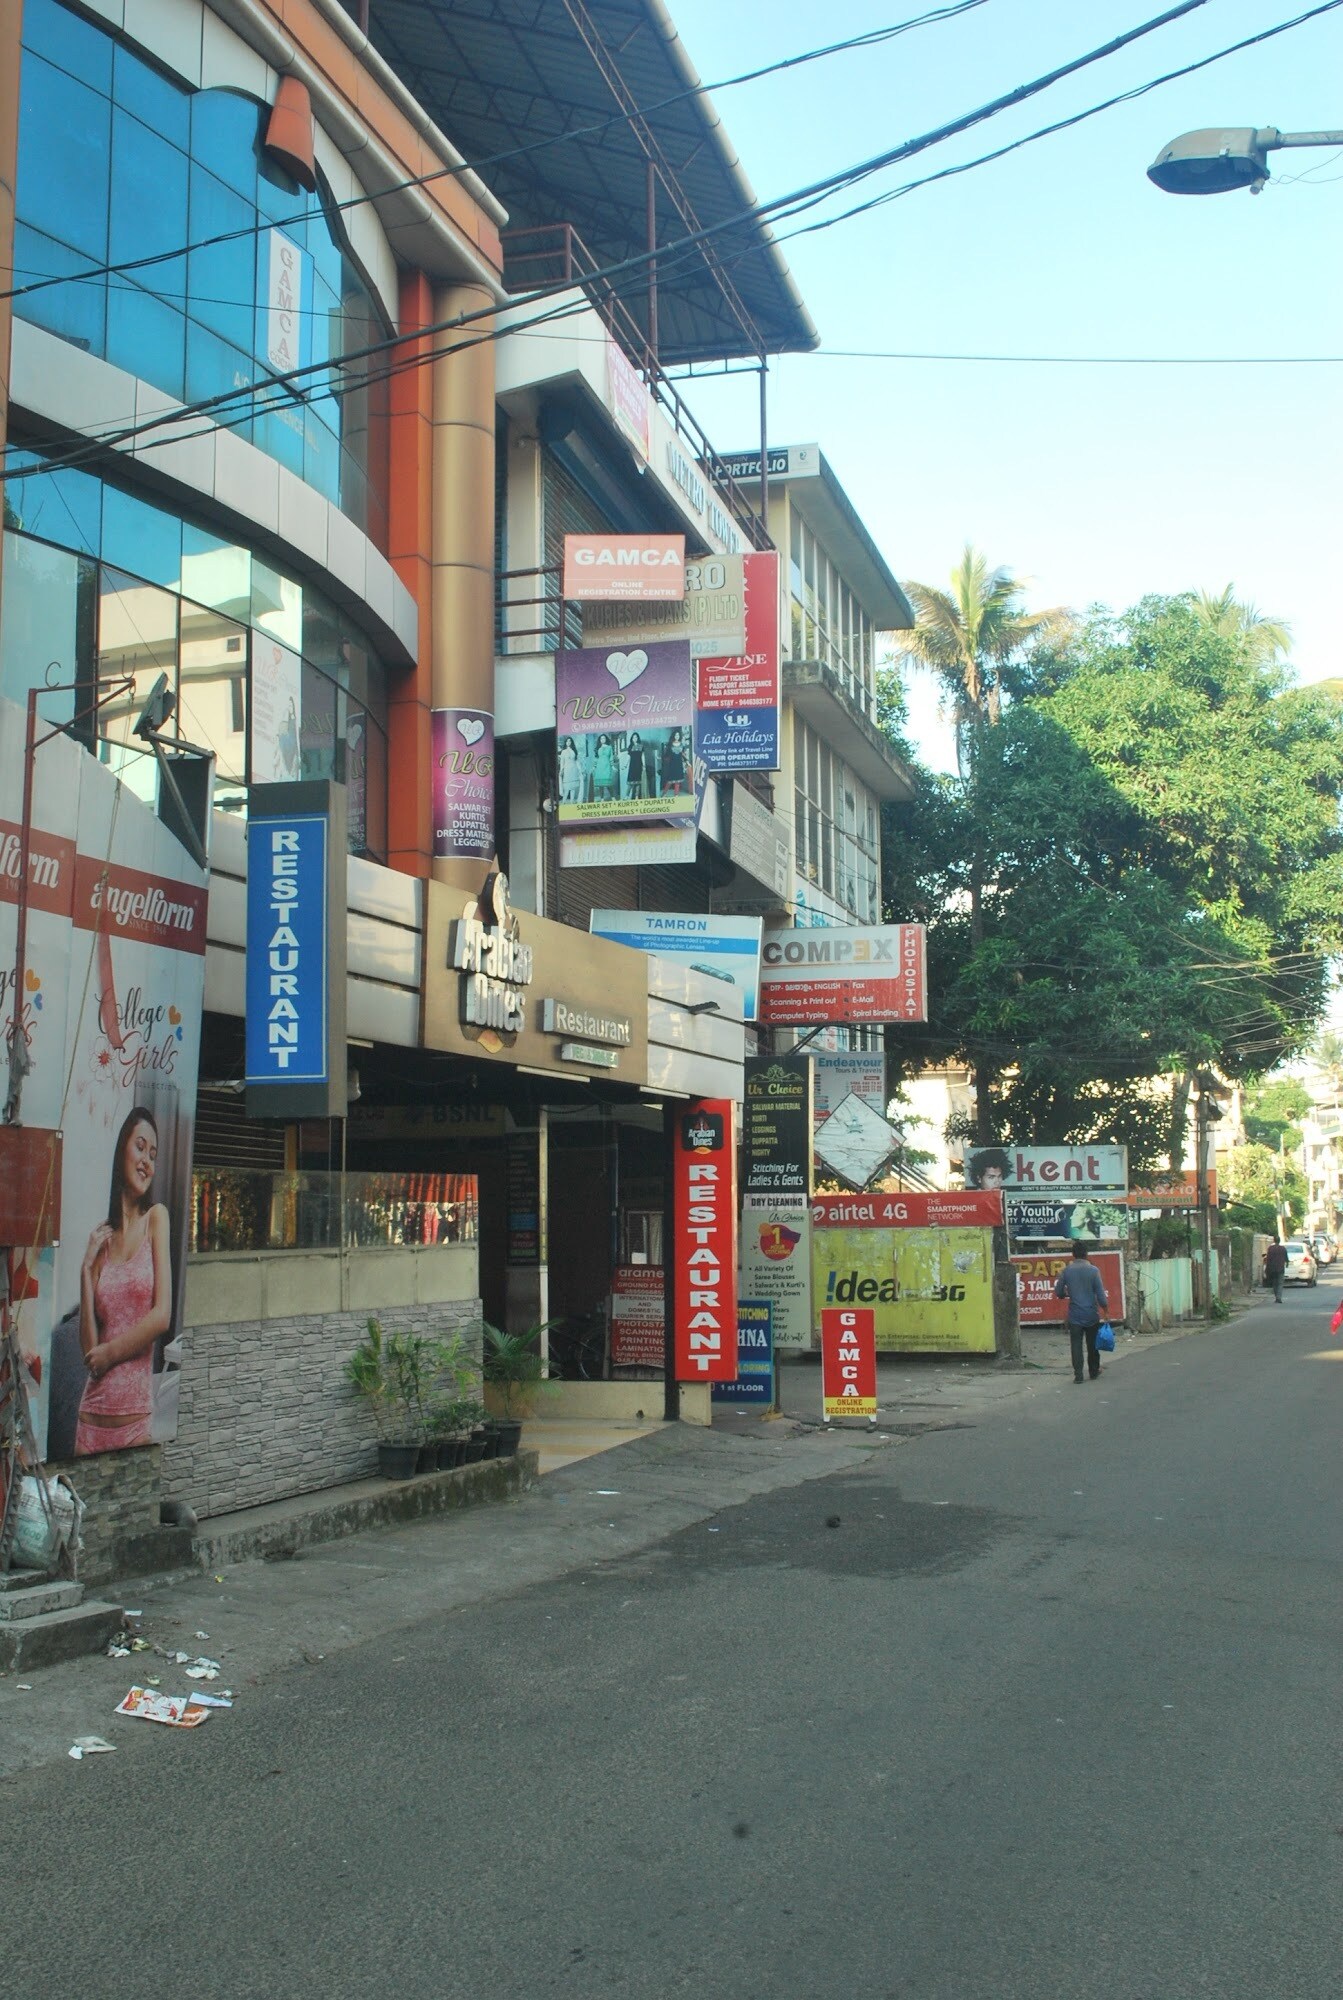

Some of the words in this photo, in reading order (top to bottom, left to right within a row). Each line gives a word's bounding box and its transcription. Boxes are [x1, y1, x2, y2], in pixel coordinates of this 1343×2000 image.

[278, 247, 294, 360] GAMCA
[574, 549, 681, 566] GAMCA
[586, 605, 632, 629] KURIES
[650, 600, 692, 625] LOANS
[695, 595, 711, 627] (P)
[715, 594, 739, 620] LTD
[709, 682, 737, 690] PASSPORT
[739, 680, 772, 688] ASSISTANCE
[723, 688, 756, 696] ASSISTANCE
[562, 694, 626, 720] UR
[630, 694, 686, 715] Choice
[720, 699, 734, 707] STAY
[702, 733, 721, 745] Lia
[724, 730, 775, 746] Holidays
[728, 753, 769, 761] OPERATORS
[448, 803, 480, 812] SALWAR
[482, 805, 491, 815] SET
[577, 802, 600, 811] SALWAR
[618, 800, 639, 808] KURTIS
[644, 798, 675, 806] DUPATTAS
[460, 811, 486, 822] KURTIS
[581, 810, 601, 818] DRESS
[602, 808, 635, 817] MATERIALS
[640, 806, 670, 814] LEGGINGS
[453, 820, 489, 832] DUPATTAS
[437, 829, 464, 838] DRESS
[454, 838, 489, 849] LEGGINGS
[90, 881, 195, 932] angelform
[646, 918, 707, 931] TAMRON
[268, 830, 301, 1068] RESTAURANT
[458, 901, 533, 986] Arabian
[648, 942, 684, 950] Photographic
[904, 929, 917, 1016] PHOTOSTAT
[770, 999, 802, 1007] Scanning
[95, 987, 165, 1043] College
[770, 1012, 805, 1020] Computer
[806, 1011, 829, 1020] Typing
[873, 1009, 899, 1017] Binding
[556, 1003, 631, 1043] Restaurant
[119, 1030, 179, 1088] Girls
[818, 1057, 882, 1067] Endeavour
[747, 1084, 762, 1095] Ur
[768, 1083, 804, 1095] Choice
[752, 1103, 774, 1111] SALWAR
[775, 1102, 801, 1110] MATERIAL
[432, 1104, 497, 1123] BSNL
[688, 1128, 716, 1138] Arabian
[693, 1136, 713, 1146] Dines
[752, 1163, 784, 1174] Stitching
[786, 1163, 799, 1172] For
[1016, 1153, 1100, 1182] kent
[748, 1175, 771, 1186] Ladies
[773, 1175, 779, 1185] &
[782, 1175, 804, 1186] Gents
[751, 1197, 765, 1207] DRY
[767, 1197, 803, 1207] CLEANING
[1136, 1196, 1194, 1204] Restaurant
[829, 1203, 875, 1221] airtel
[883, 1203, 907, 1220] 4G
[927, 1205, 977, 1213] SMARTPHONE
[1020, 1206, 1054, 1217] Youth
[781, 1212, 804, 1223] Choice
[772, 1227, 780, 1245] 1
[687, 1164, 721, 1371] RESTAURANT
[838, 1312, 860, 1397] GAMCA
